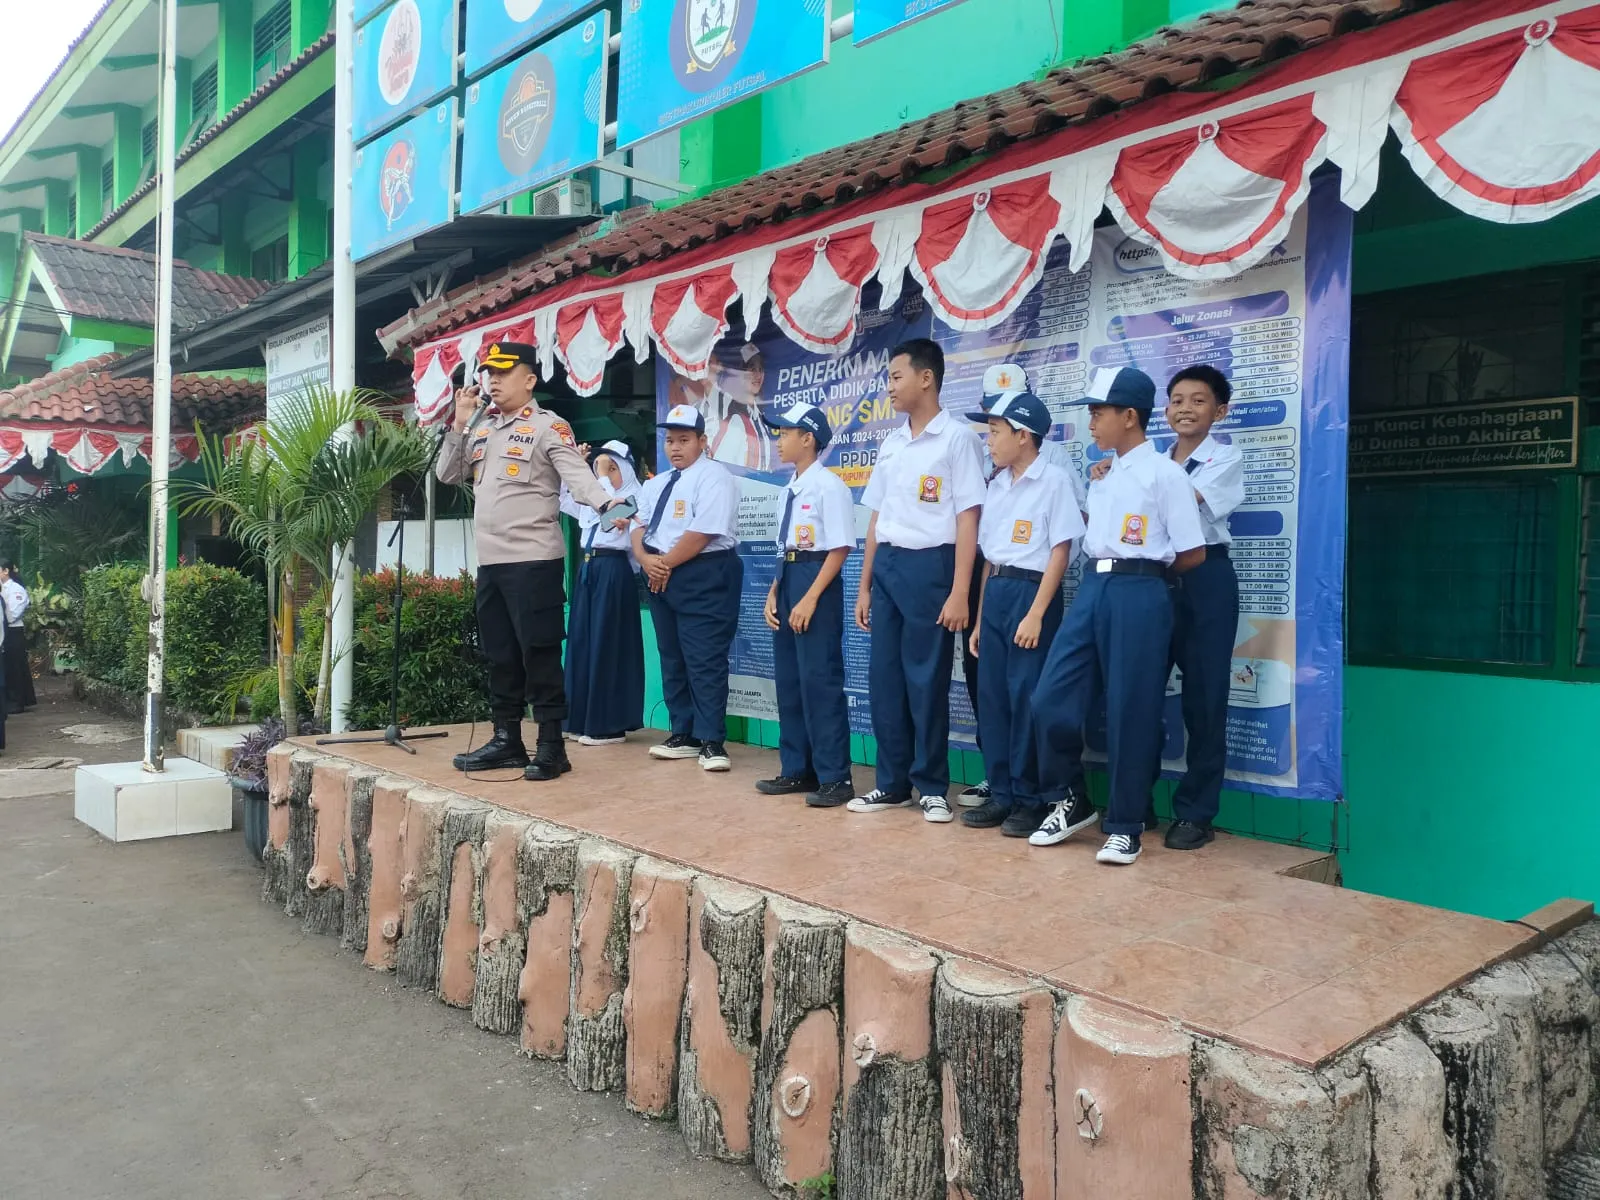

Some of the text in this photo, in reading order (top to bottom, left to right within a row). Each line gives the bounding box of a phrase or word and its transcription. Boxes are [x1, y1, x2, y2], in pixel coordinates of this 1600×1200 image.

[733, 70, 766, 93] FUTSAL
[1170, 306, 1233, 327] Jalur Zonasi
[777, 347, 889, 391] PENERIMAA
[773, 376, 889, 409] PESERTA DIDIK BA
[858, 397, 897, 424] SM
[1373, 407, 1563, 434] Kunci Kebahagiaan
[508, 434, 534, 444] POLRI
[852, 428, 896, 443] 2024-202
[1369, 433, 1420, 450] Dunia
[1426, 432, 1460, 446] dan
[1466, 426, 1541, 444] Akhirat
[840, 449, 878, 469] PPDB
[1494, 448, 1514, 461] and
[1256, 752, 1277, 764] daring
